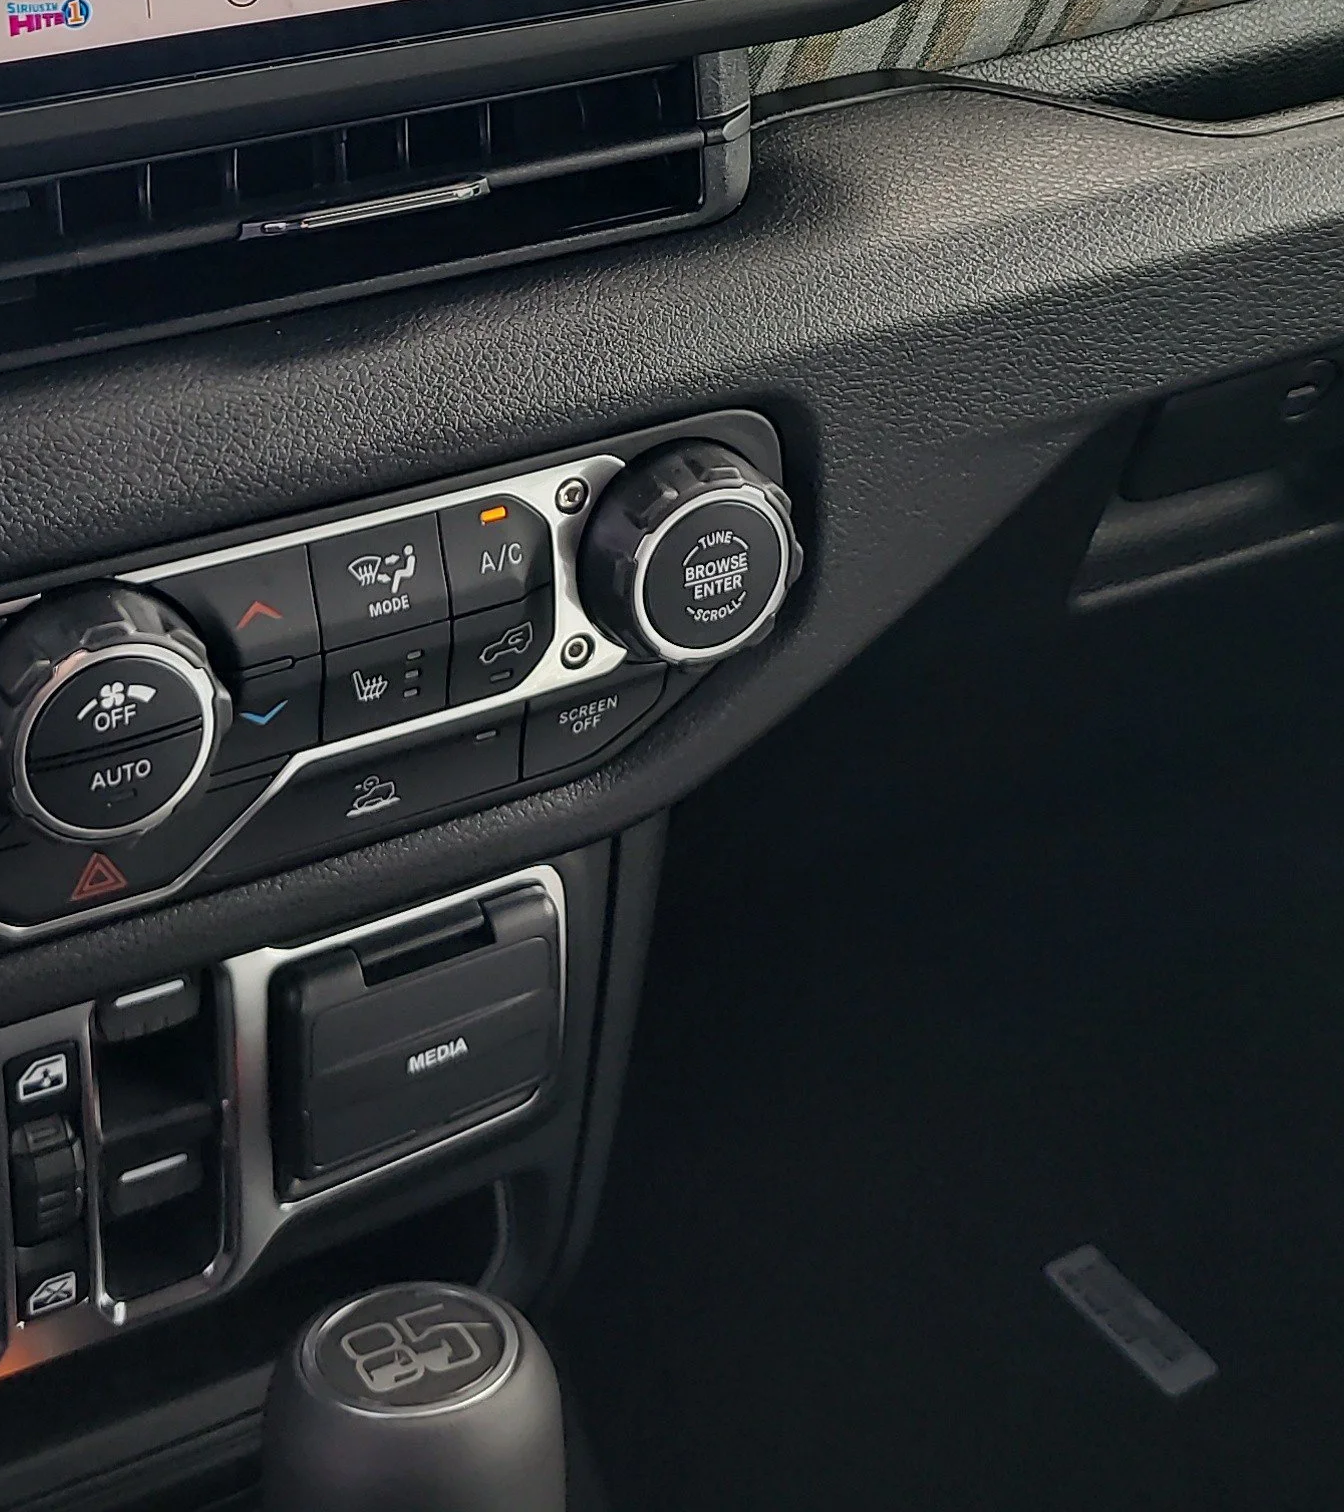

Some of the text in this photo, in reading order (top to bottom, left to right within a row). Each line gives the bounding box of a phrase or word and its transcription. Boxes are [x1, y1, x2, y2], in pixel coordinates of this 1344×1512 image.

[698, 531, 733, 549] TUNE
[480, 543, 523, 574] A/C
[685, 552, 748, 582] BROWSE
[694, 575, 743, 600] ENTER
[369, 593, 411, 618] MODE
[694, 600, 742, 622] SCROLL
[93, 705, 137, 732] OFF
[559, 695, 619, 726] SCREEN
[572, 713, 602, 735] OFF
[89, 757, 152, 791] AUTO
[408, 1037, 468, 1074] MEDIA
